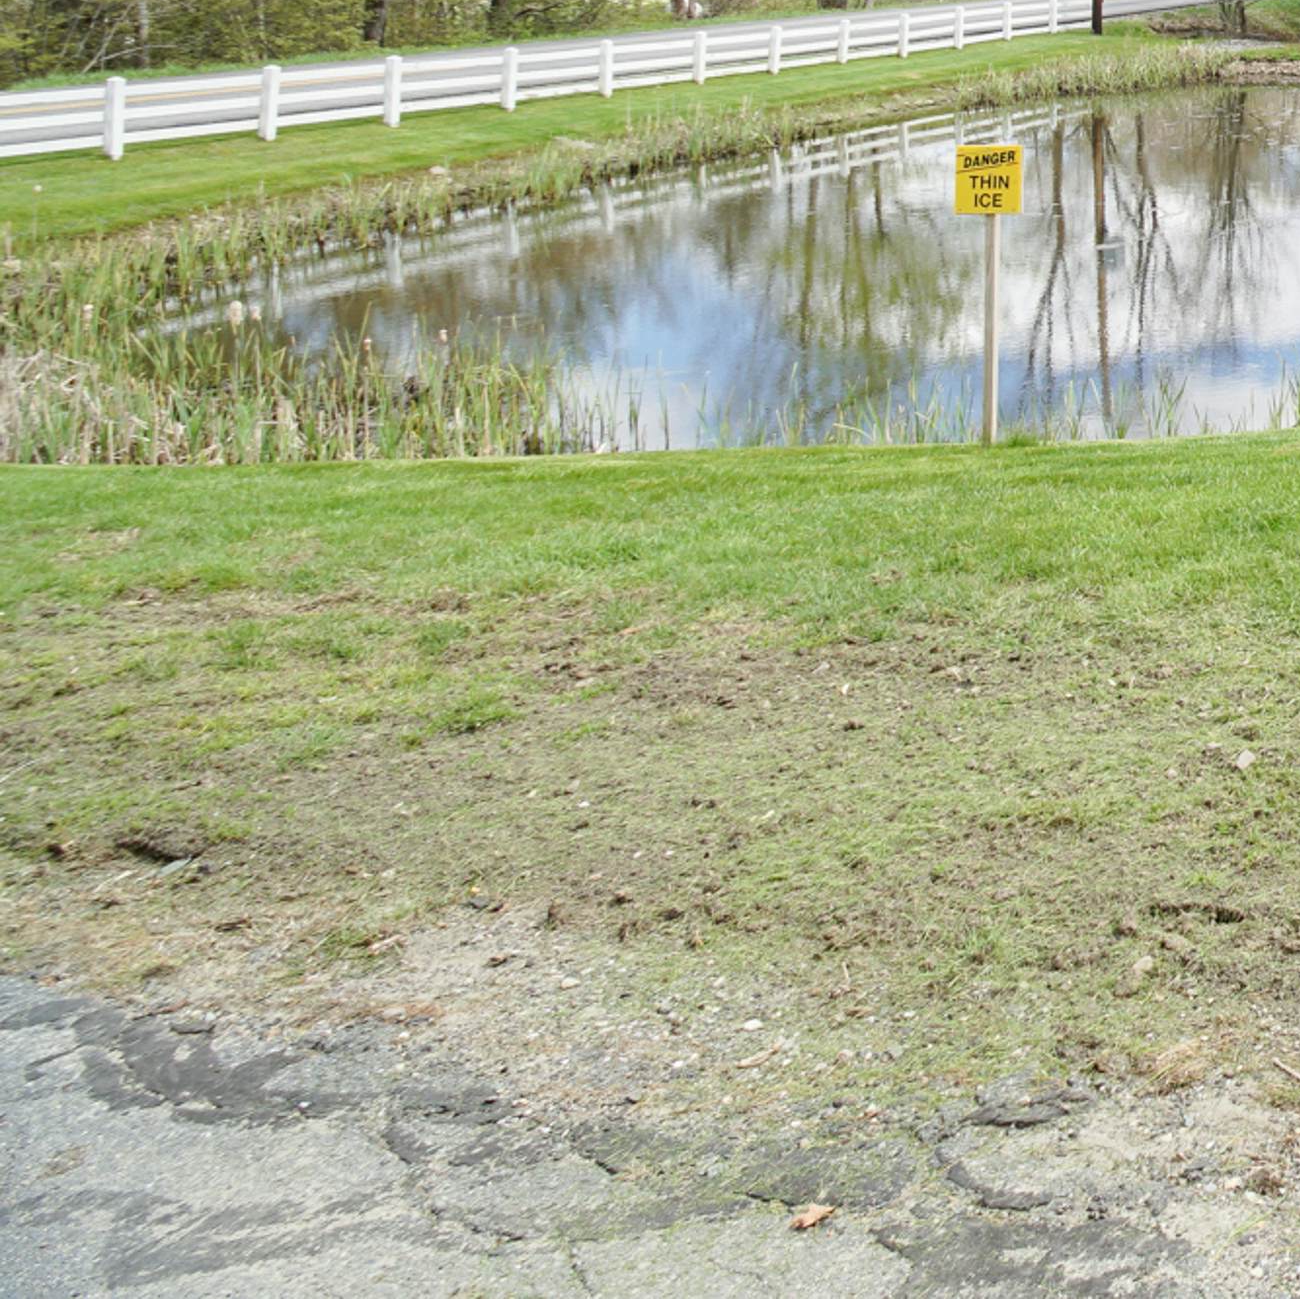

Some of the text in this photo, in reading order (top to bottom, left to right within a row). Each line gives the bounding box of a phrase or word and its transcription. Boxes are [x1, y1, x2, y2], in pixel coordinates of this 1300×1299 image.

[964, 150, 1016, 169] DANGER
[969, 175, 1009, 189] THIN
[974, 193, 1003, 208] ICE
